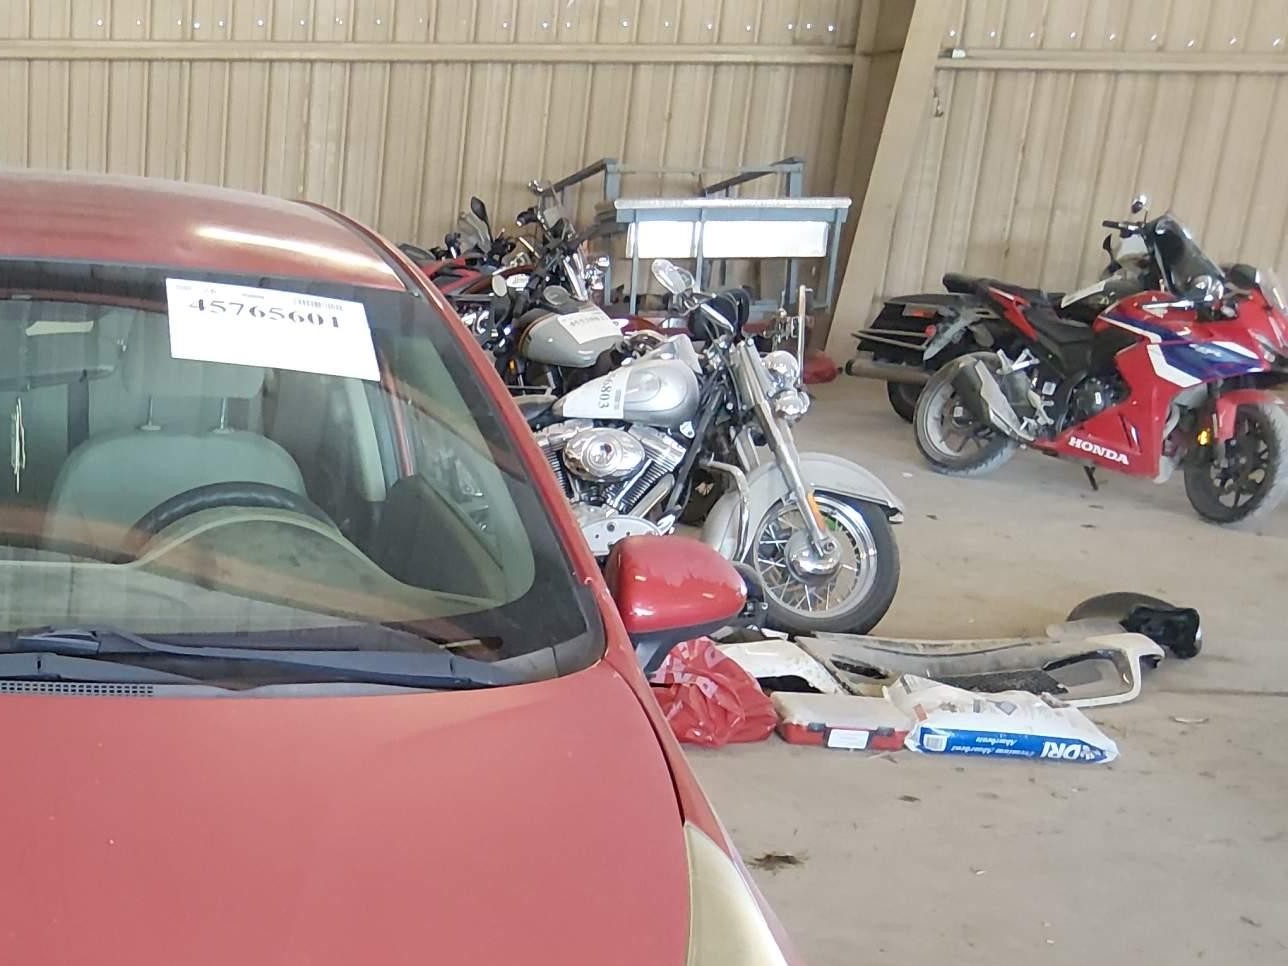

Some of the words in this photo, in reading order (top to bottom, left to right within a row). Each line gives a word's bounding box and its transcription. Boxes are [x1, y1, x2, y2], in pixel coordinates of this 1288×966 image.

[189, 298, 340, 328] 45765601
[1068, 436, 1129, 465] HONDA
[1040, 741, 1082, 760] DRI
